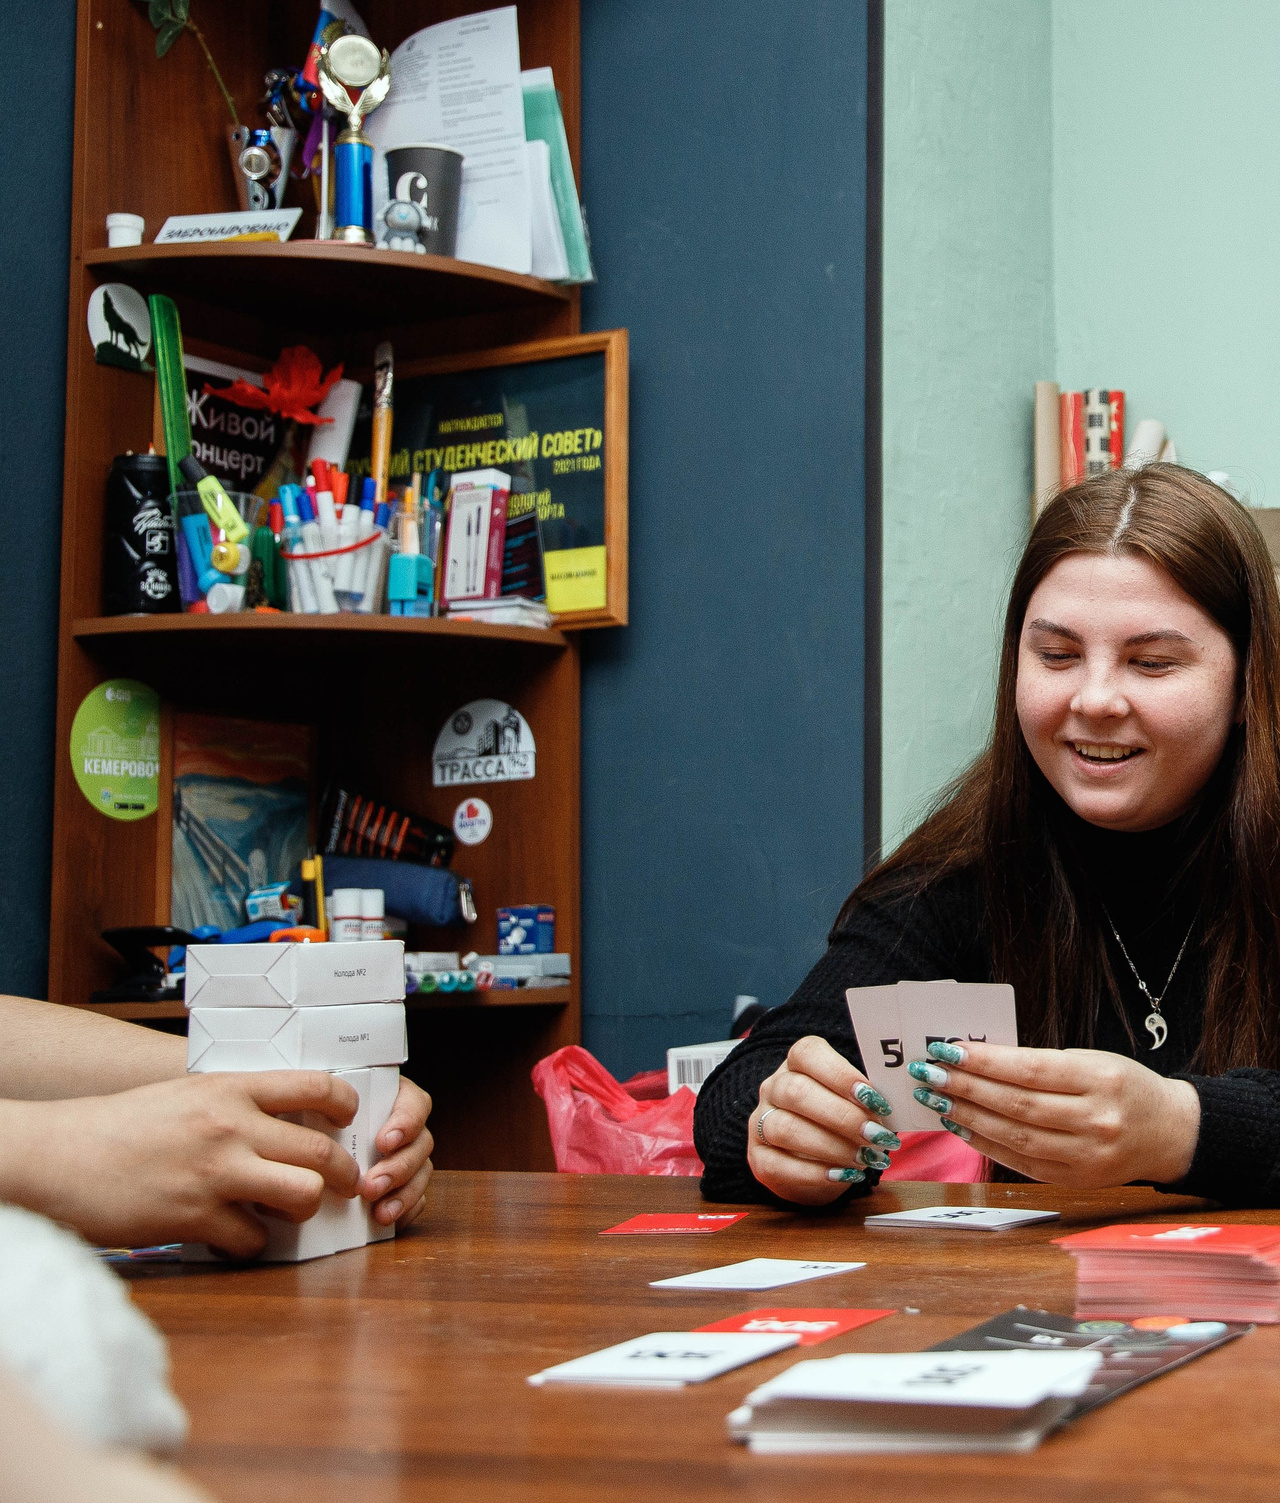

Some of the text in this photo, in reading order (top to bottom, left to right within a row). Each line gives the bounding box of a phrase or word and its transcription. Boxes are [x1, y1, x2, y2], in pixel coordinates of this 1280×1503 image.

[191, 439, 265, 480] онцерт
[413, 430, 539, 475] СТУДЕНЧЕСКИЙ
[541, 427, 603, 459] СОВЕТ»
[438, 758, 506, 782] ТРАССА
